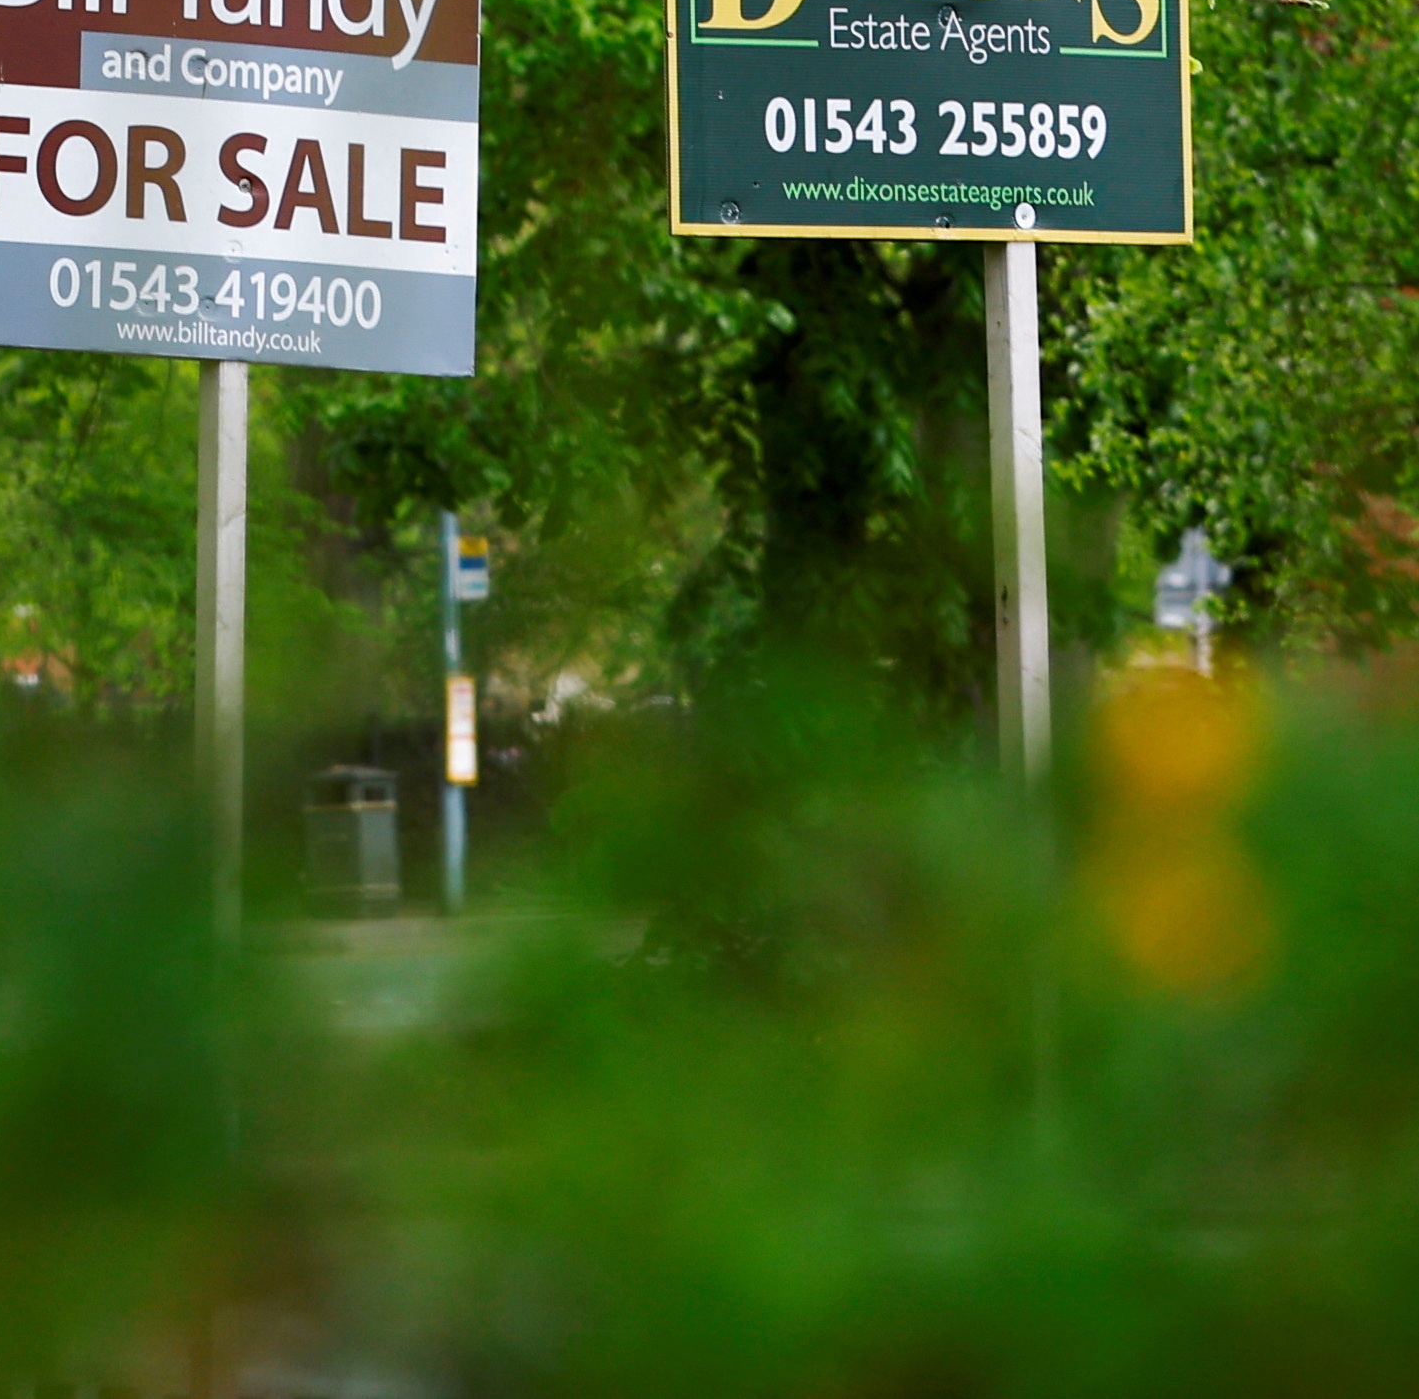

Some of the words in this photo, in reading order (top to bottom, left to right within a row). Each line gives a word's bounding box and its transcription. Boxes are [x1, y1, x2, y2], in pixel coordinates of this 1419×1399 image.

[829, 8, 931, 51] Estate
[940, 13, 1051, 64] Agents
[102, 46, 172, 83] and
[180, 48, 344, 106] Company
[764, 97, 918, 155] 01543
[938, 101, 1108, 160] 255859
[217, 132, 447, 244] SALE
[782, 177, 1095, 212] www.dixonsestateagents.co.uk
[49, 257, 200, 315] 01543
[213, 270, 382, 330] 419400
[116, 322, 322, 354] www.billtandy.co.uk
